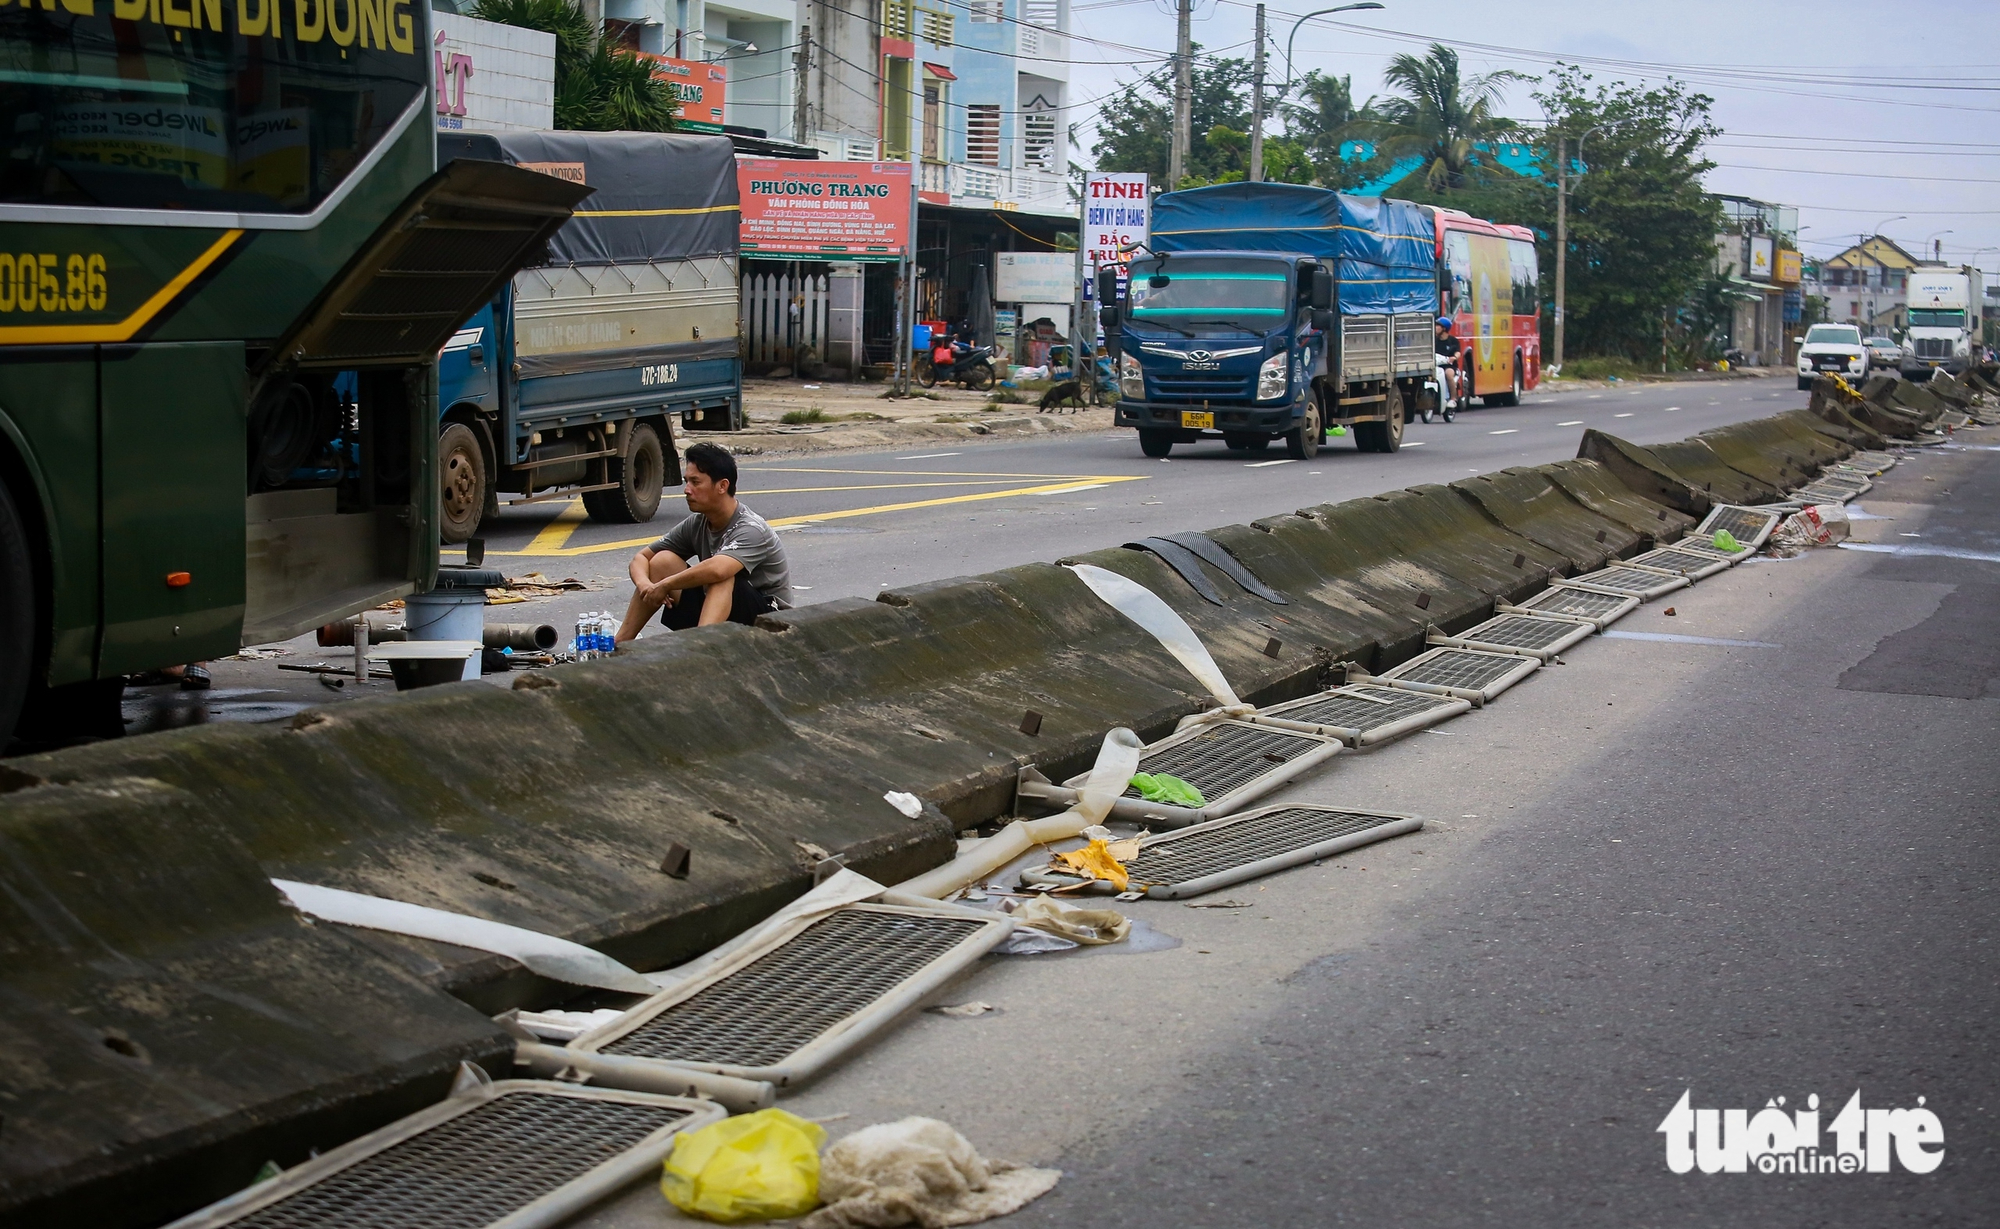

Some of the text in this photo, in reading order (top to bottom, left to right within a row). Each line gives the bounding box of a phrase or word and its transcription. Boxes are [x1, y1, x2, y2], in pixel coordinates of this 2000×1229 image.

[750, 180, 890, 197] PHƯƠNG TRANG
[1089, 178, 1144, 199] TÌNH
[768, 198, 788, 209] VĂN
[789, 198, 821, 209] PHÒNG
[1089, 201, 1105, 226] ĐIỂM
[1106, 203, 1115, 226] KÝ
[1127, 204, 1145, 227] HÀNG
[1099, 229, 1130, 245] BẮC
[641, 363, 678, 386] 47C-186.24
[1182, 363, 1220, 371] ISUZU
[1185, 420, 1211, 428] 005.19
